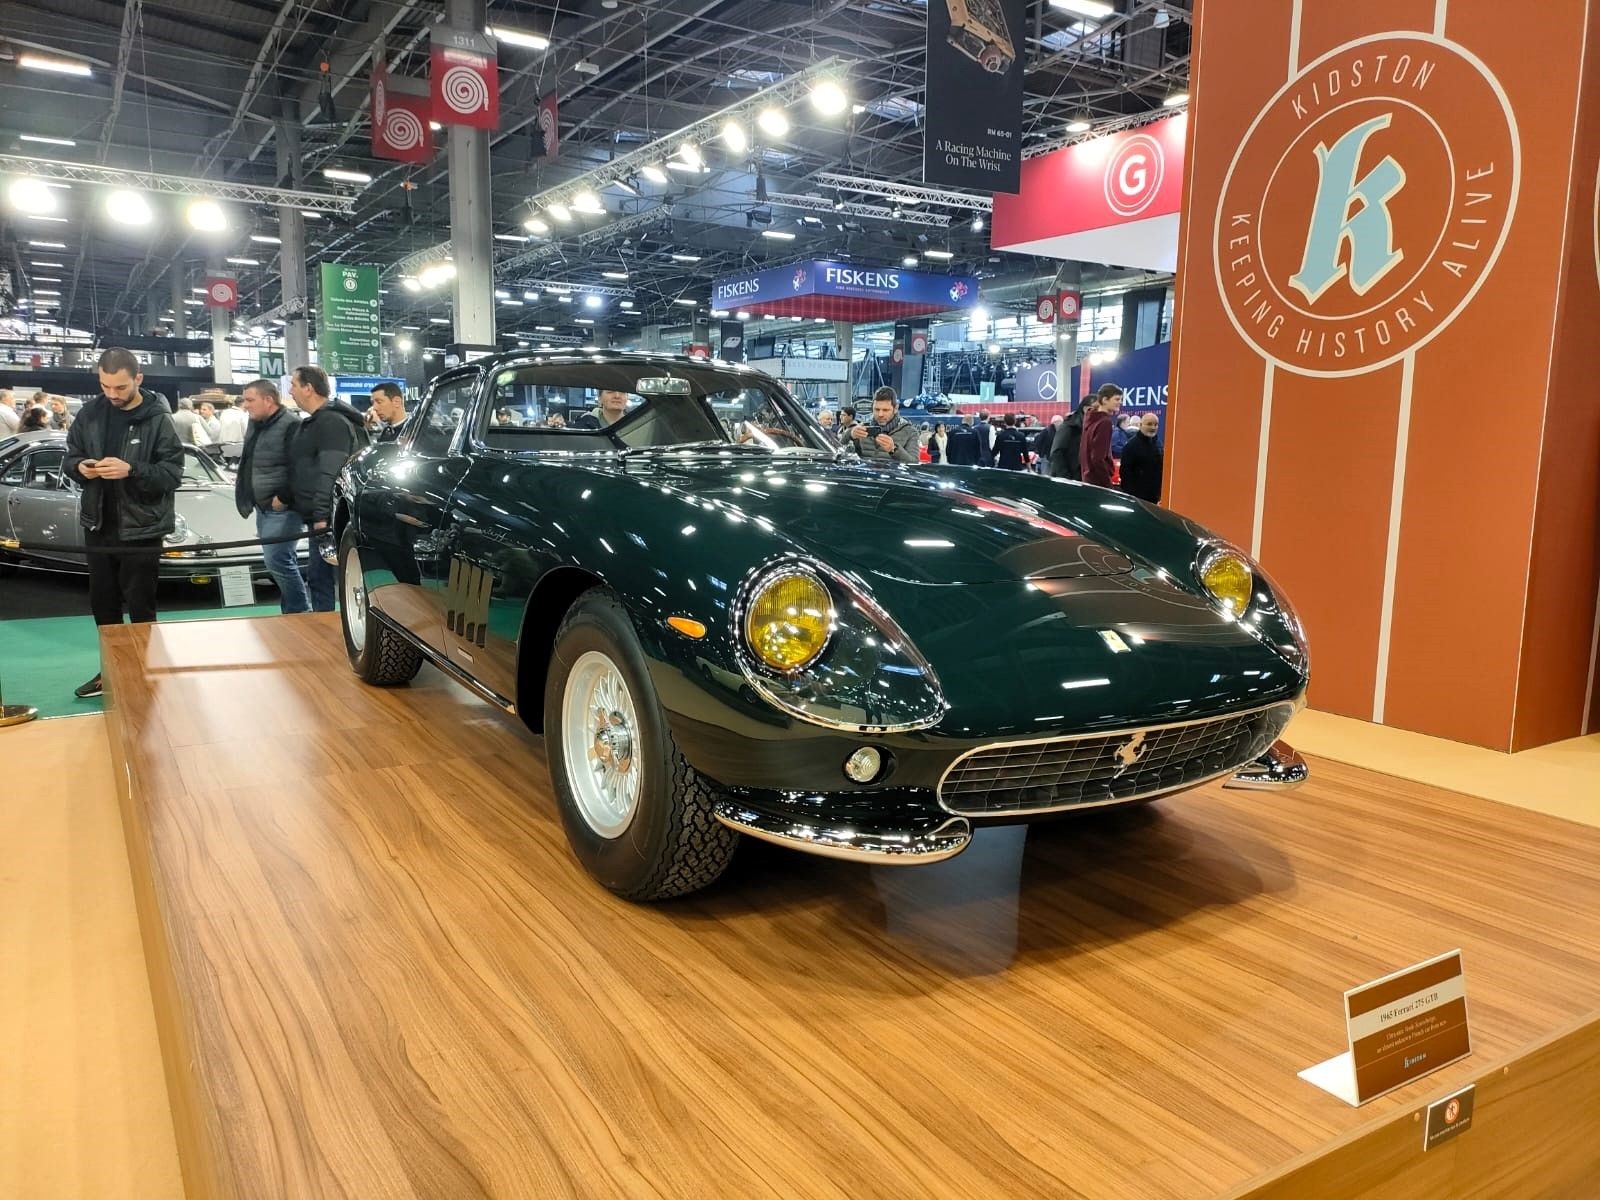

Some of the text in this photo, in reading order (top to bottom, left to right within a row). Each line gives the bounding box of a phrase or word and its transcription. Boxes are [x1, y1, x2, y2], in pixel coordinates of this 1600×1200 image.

[453, 34, 475, 48] 1311
[1291, 54, 1436, 120] KIDSTON
[935, 139, 1012, 161] A Racing Machine
[945, 153, 1001, 172] On The Wrist
[1118, 153, 1147, 197] G
[1229, 160, 1494, 358] KEEPING HISTORY ALIVE
[718, 277, 760, 300] FISKENS
[826, 266, 899, 289] FISKENS
[261, 357, 283, 376] M
[1121, 384, 1169, 407] KENS
[1380, 1010, 1393, 1023] 1965
[1394, 1003, 1415, 1017] Ferrari
[1415, 997, 1425, 1009] 275
